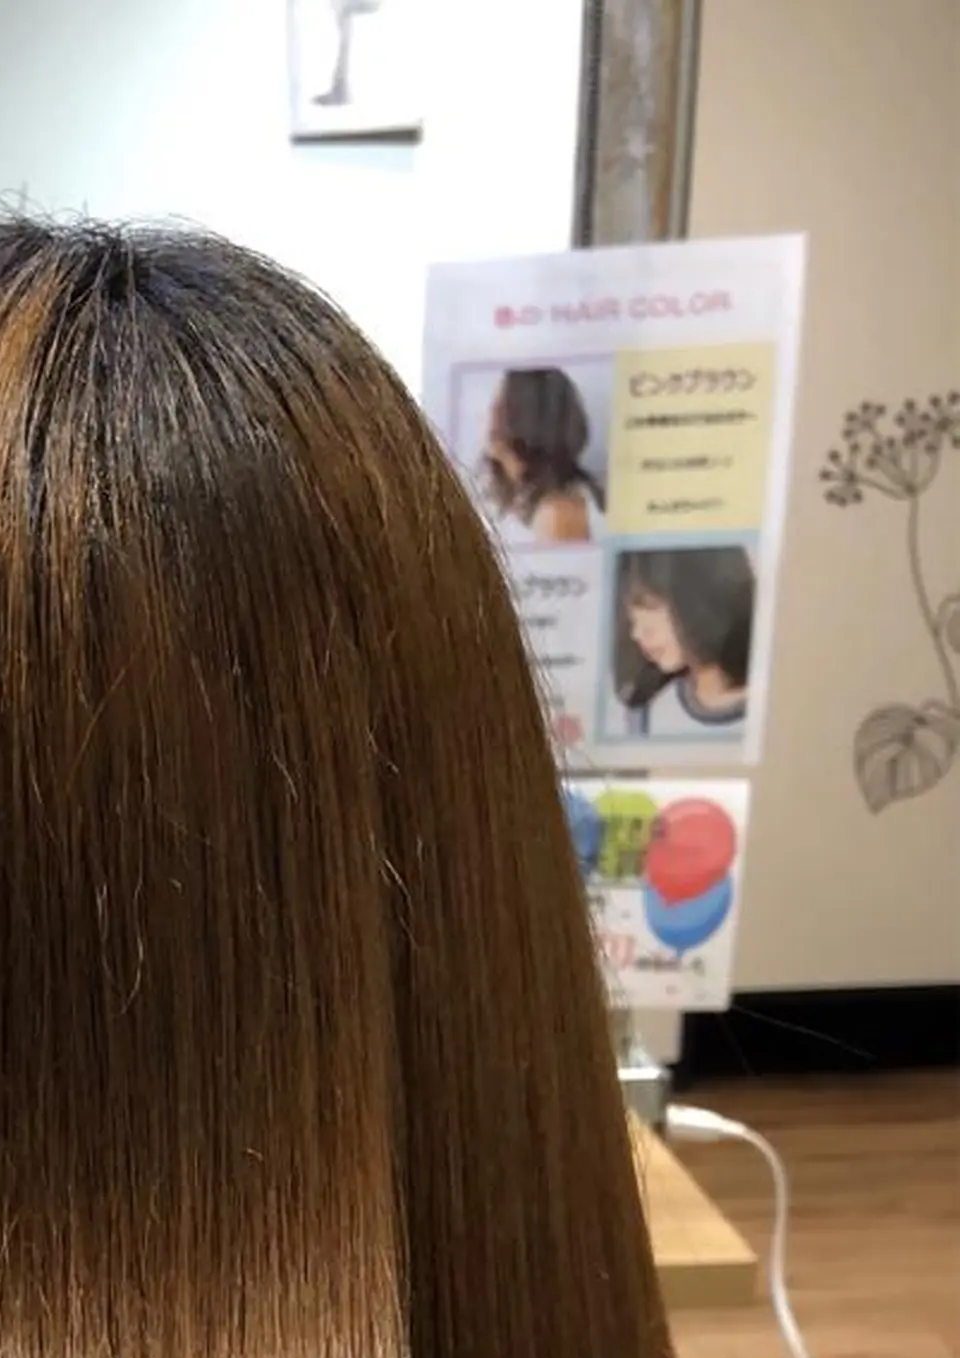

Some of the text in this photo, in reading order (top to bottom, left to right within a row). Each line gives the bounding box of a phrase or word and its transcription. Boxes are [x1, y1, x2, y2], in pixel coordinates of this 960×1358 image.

[550, 294, 621, 324] HAIR
[629, 288, 735, 320] COLOR
[629, 367, 756, 398] ピンクブラウン
